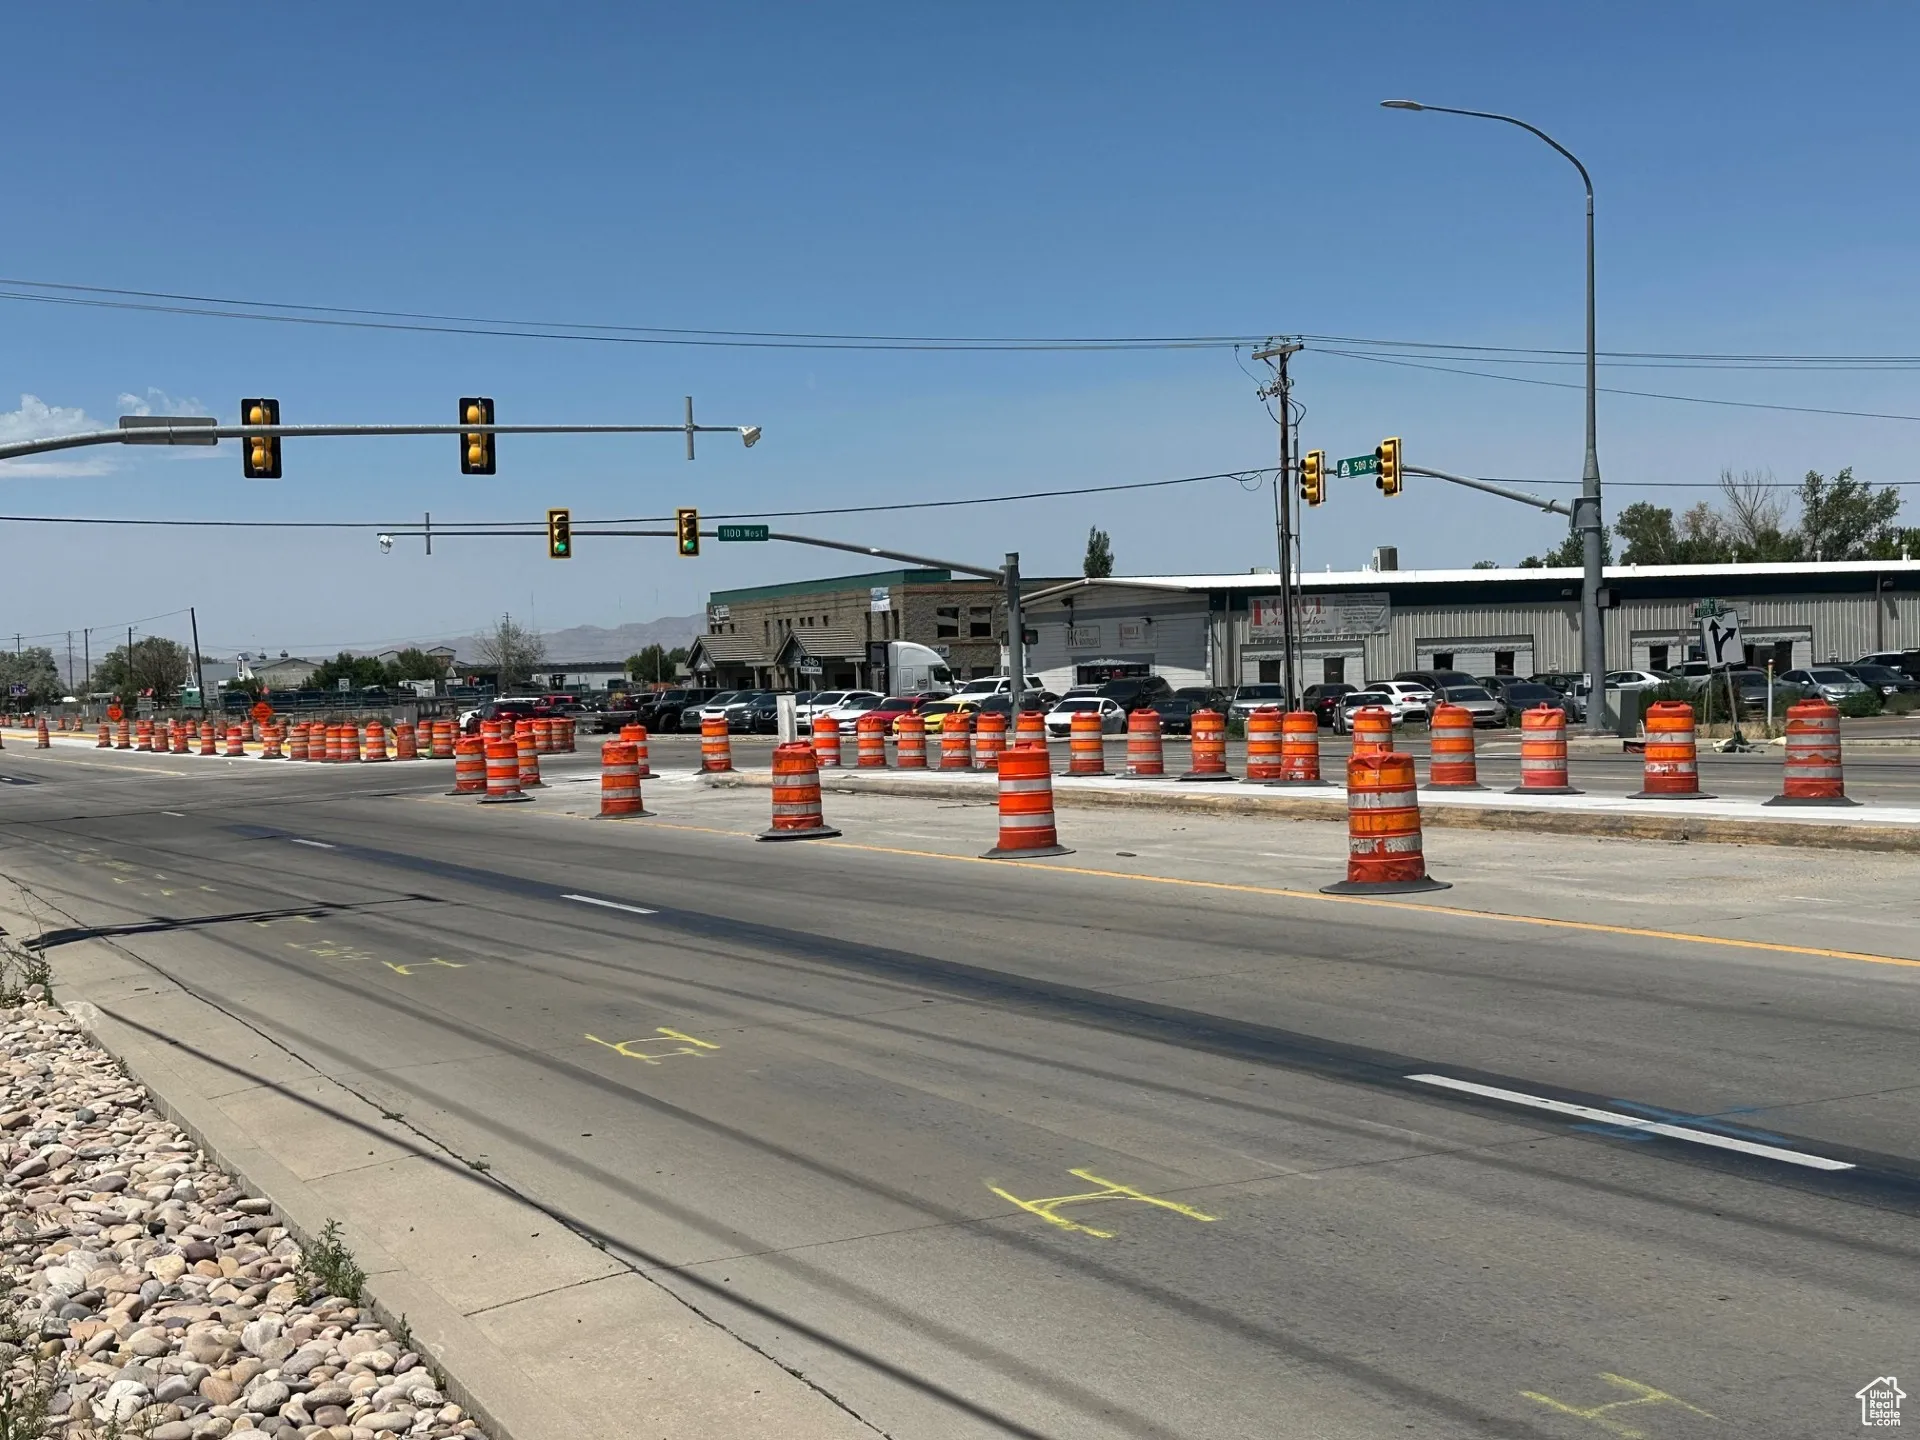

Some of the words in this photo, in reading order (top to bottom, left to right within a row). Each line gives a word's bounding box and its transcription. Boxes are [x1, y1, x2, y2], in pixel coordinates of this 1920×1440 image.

[1354, 460, 1367, 472] 500
[723, 528, 741, 538] 1100
[744, 528, 764, 538] West
